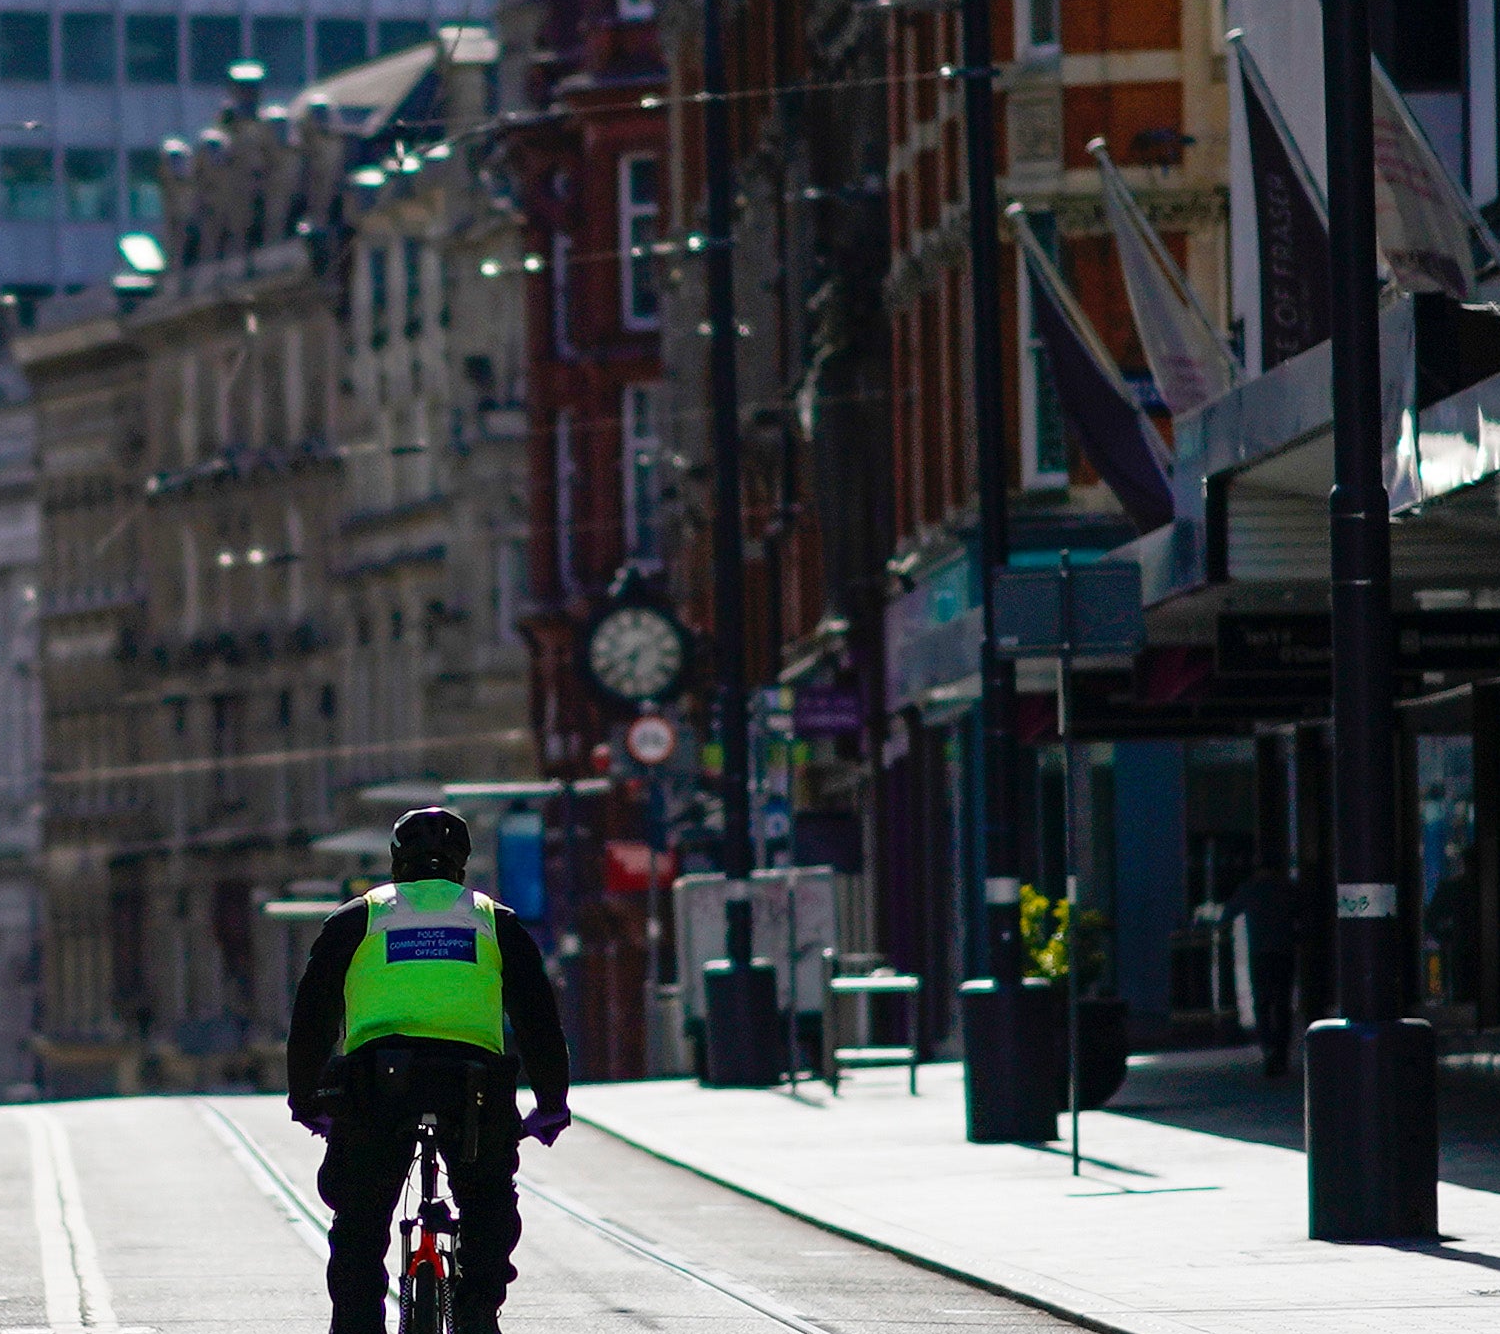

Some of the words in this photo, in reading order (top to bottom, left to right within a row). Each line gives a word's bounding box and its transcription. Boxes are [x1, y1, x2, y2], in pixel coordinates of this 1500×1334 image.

[417, 930, 446, 939] POLICE
[389, 940, 436, 951] COMMUNITY
[437, 939, 473, 948] SUPPORT
[414, 948, 450, 957] OFFICER
